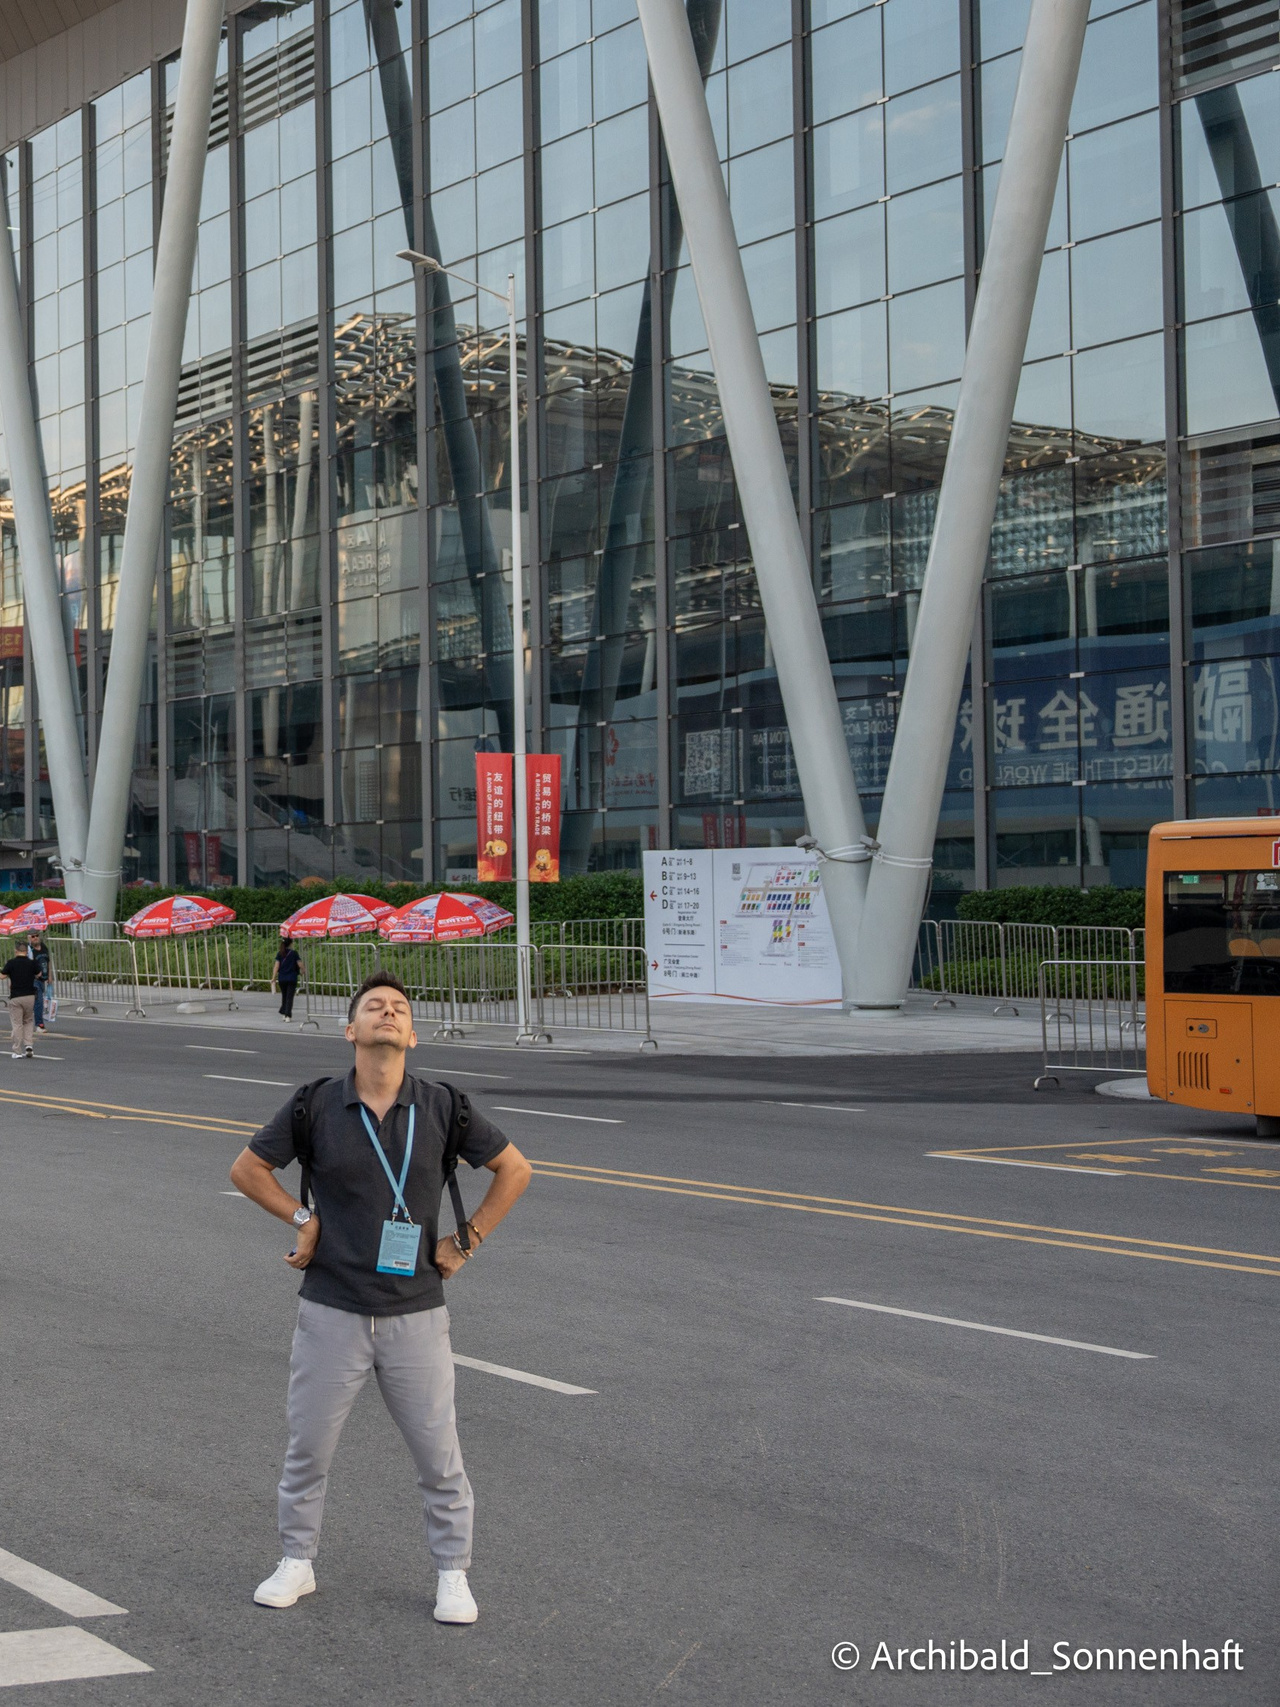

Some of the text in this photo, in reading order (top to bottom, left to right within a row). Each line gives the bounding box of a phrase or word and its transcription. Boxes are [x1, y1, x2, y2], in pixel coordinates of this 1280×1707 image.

[493, 772, 504, 835] 友谊的纽带
[541, 773, 552, 836] 贸易的桥梁
[438, 915, 473, 925] EMTOP
